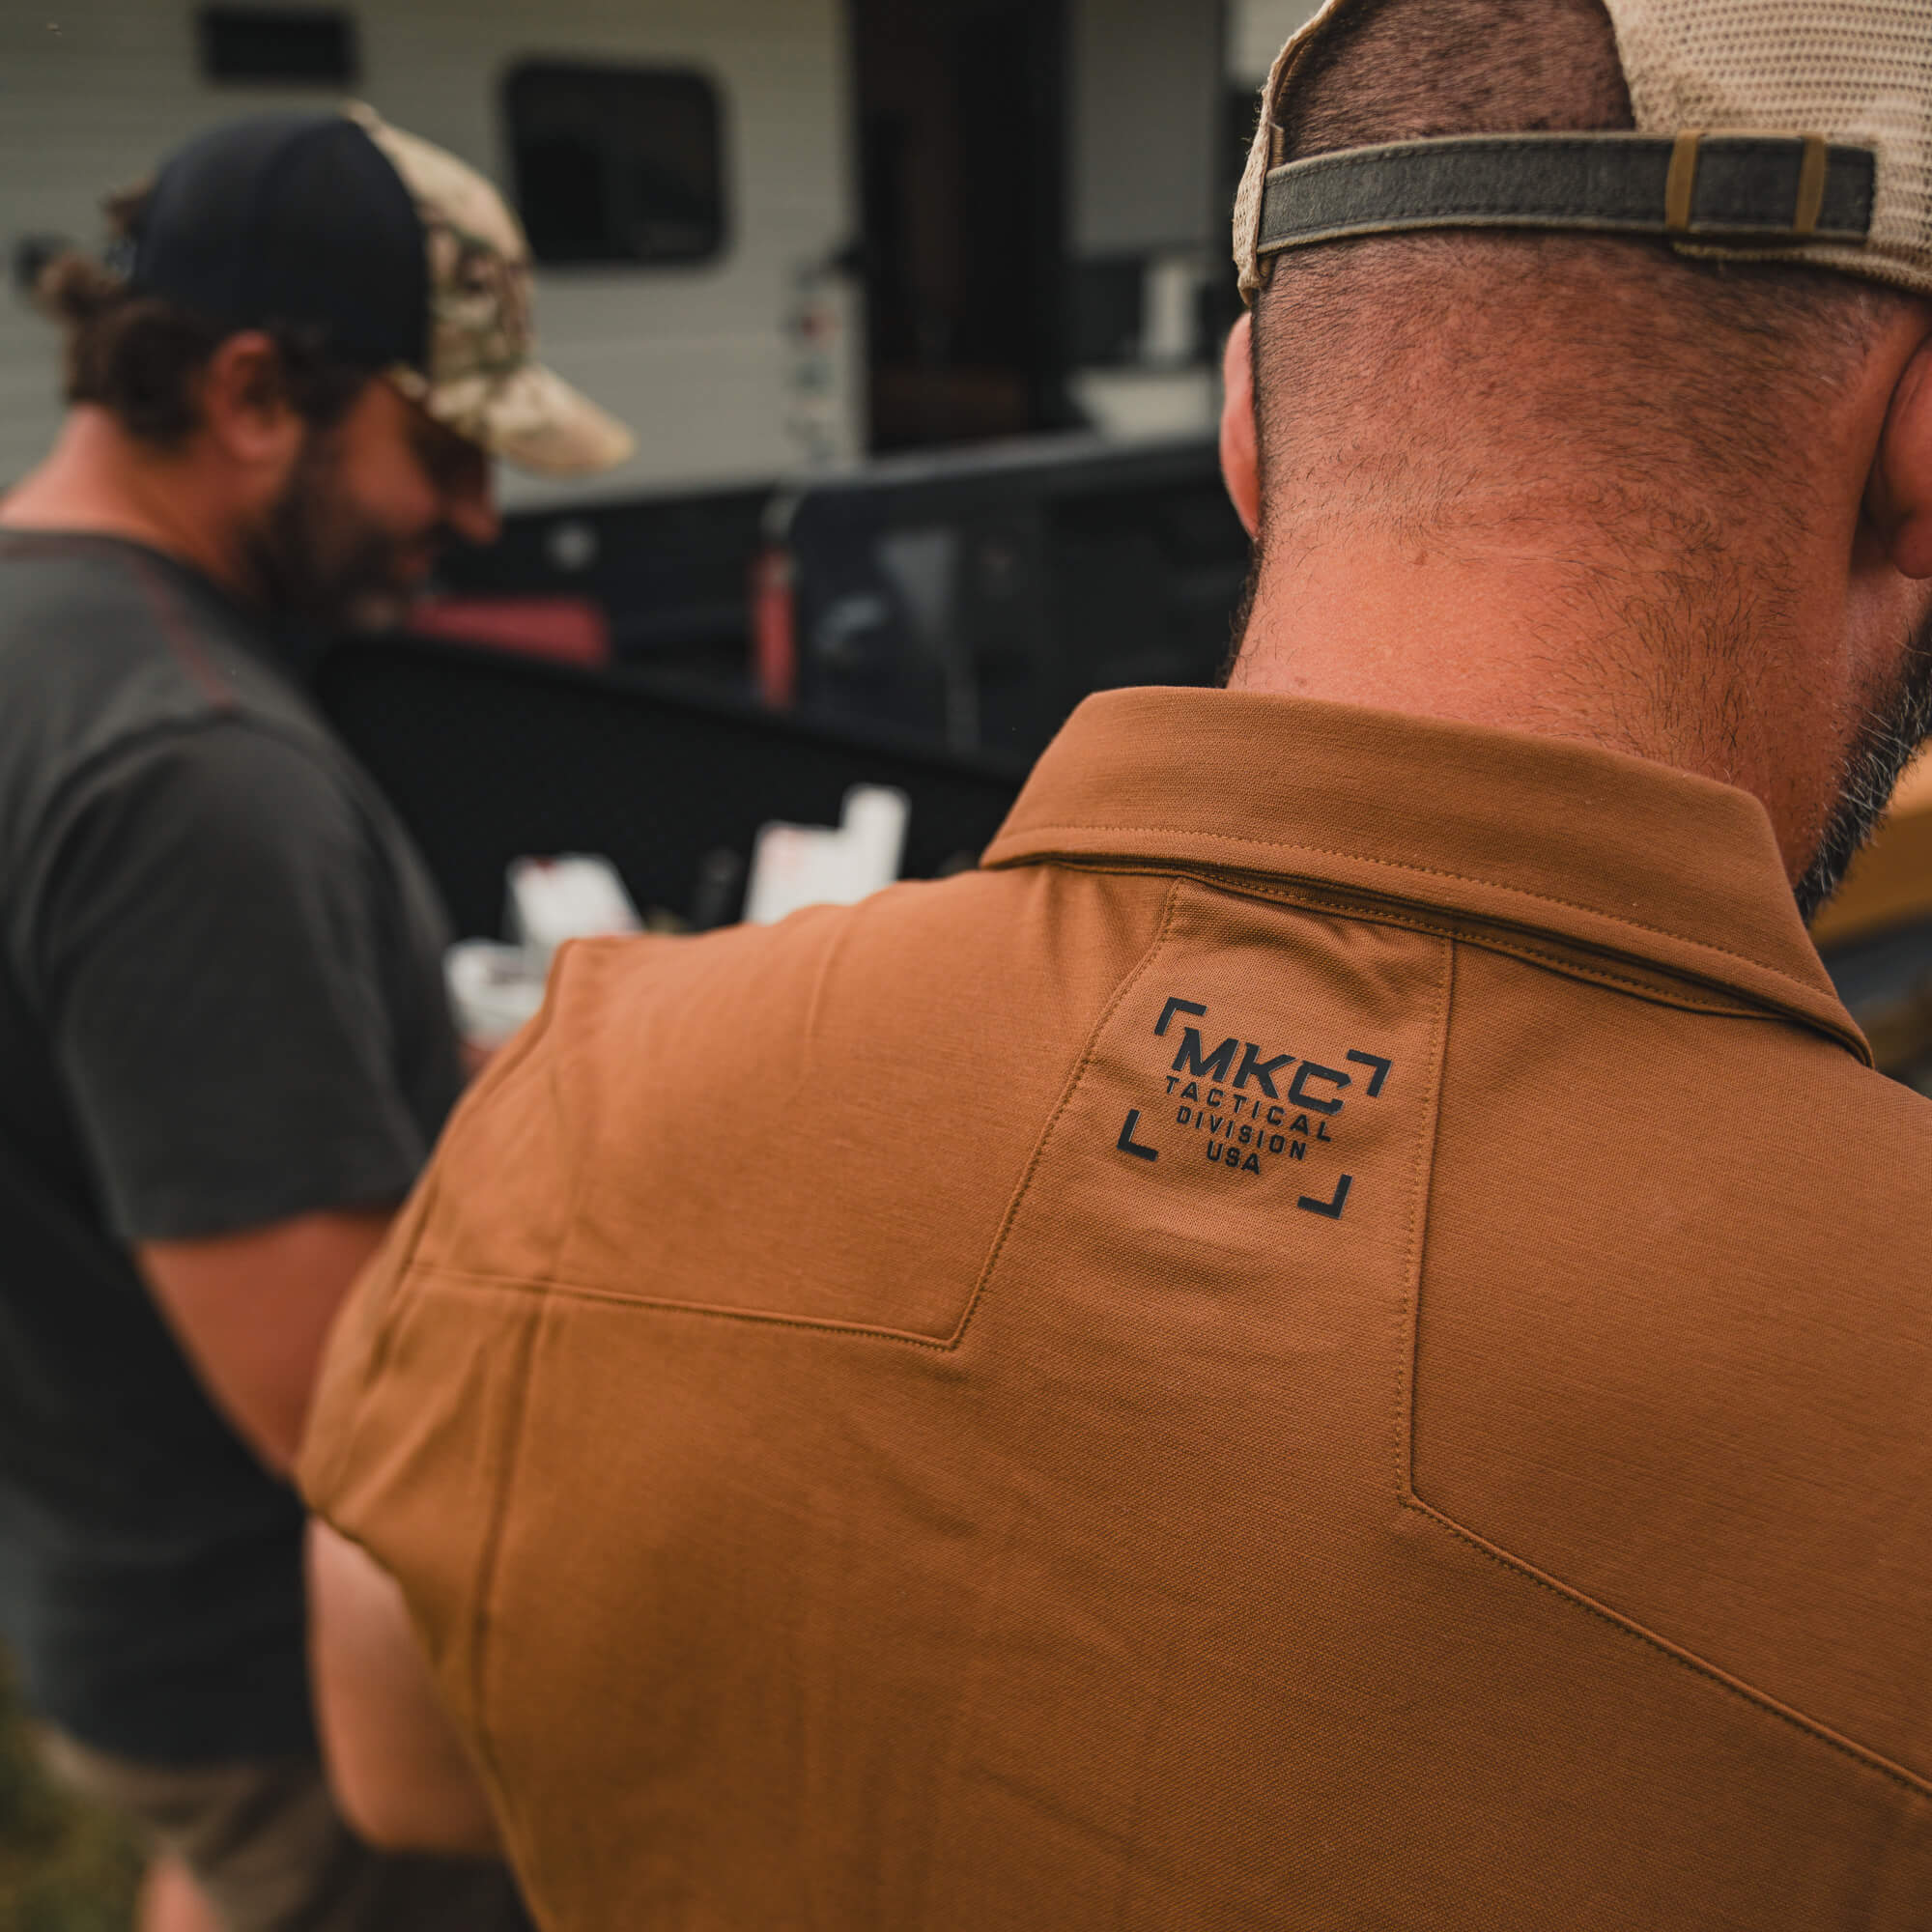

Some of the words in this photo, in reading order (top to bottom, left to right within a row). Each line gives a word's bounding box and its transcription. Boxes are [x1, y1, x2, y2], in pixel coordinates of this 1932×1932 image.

[1171, 1026, 1352, 1117] MKC
[1166, 1075, 1332, 1143] TACTICAL
[1176, 1105, 1307, 1161] DIVISION
[1206, 1139, 1262, 1176] USA
